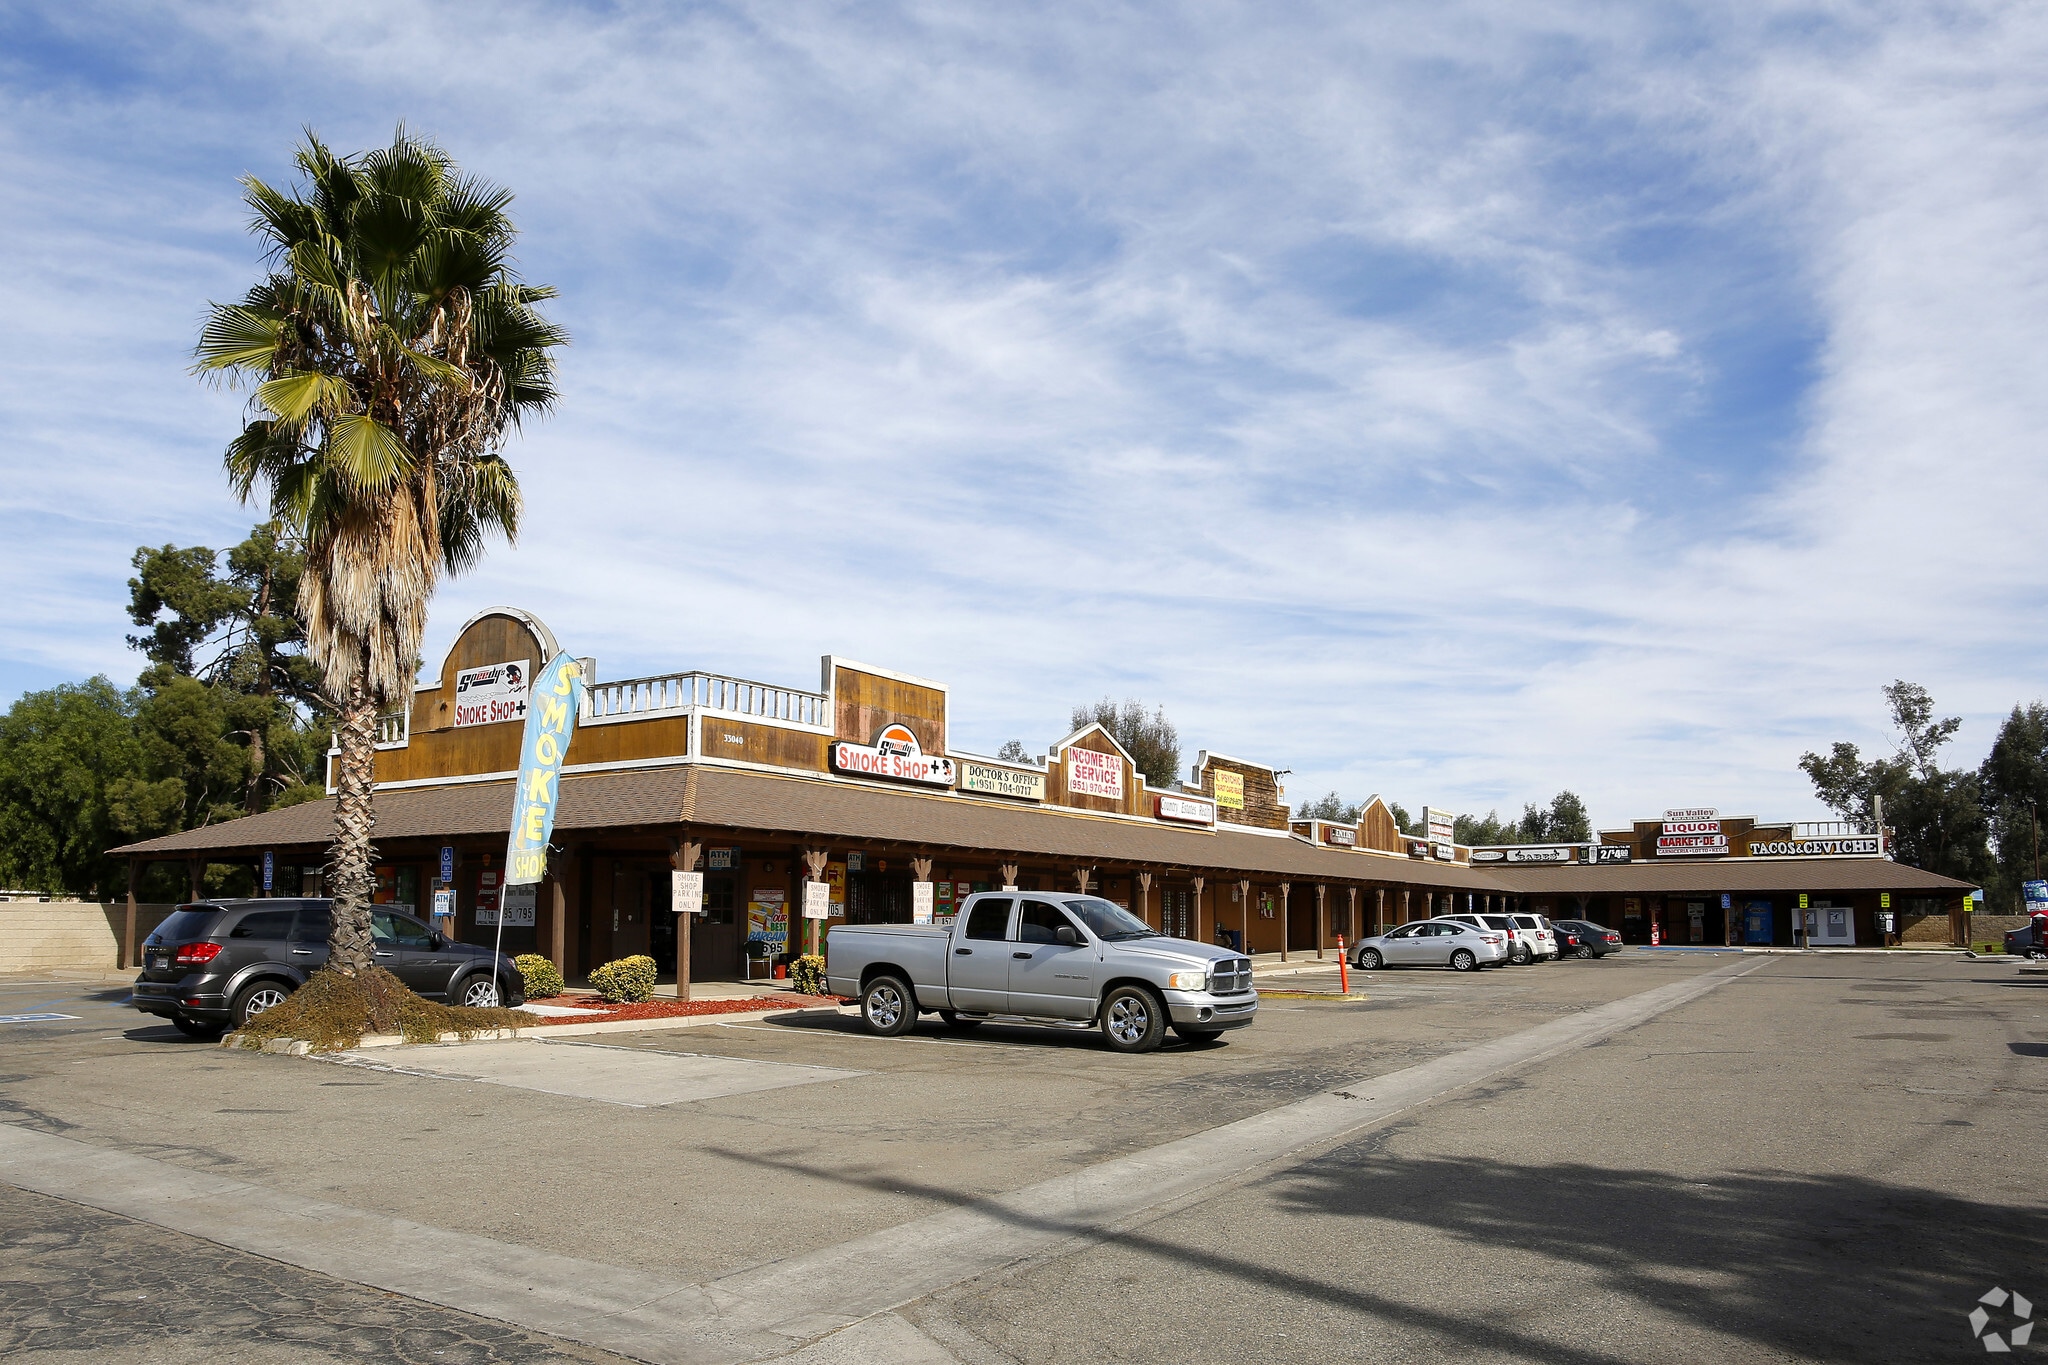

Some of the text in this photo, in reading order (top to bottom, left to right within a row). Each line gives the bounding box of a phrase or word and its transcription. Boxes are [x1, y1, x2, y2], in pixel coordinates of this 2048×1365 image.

[525, 664, 576, 842] SMOKE
[1069, 748, 1121, 771] INCOME TAX
[969, 766, 1039, 787] DOCTOR'S OFFICE
[1075, 765, 1116, 785] SERVICE
[976, 778, 1032, 796] (951) 704-0717
[1070, 779, 1121, 797] (951) 970-4707
[1664, 823, 1718, 833] LIQUOR
[677, 873, 699, 882] SMOKE
[680, 882, 698, 890] SHOP
[435, 894, 449, 903] ATM
[678, 901, 696, 909] ONLY
[773, 914, 787, 922] OUR
[771, 922, 787, 931] BEST
[748, 931, 788, 942] BARGAIN
